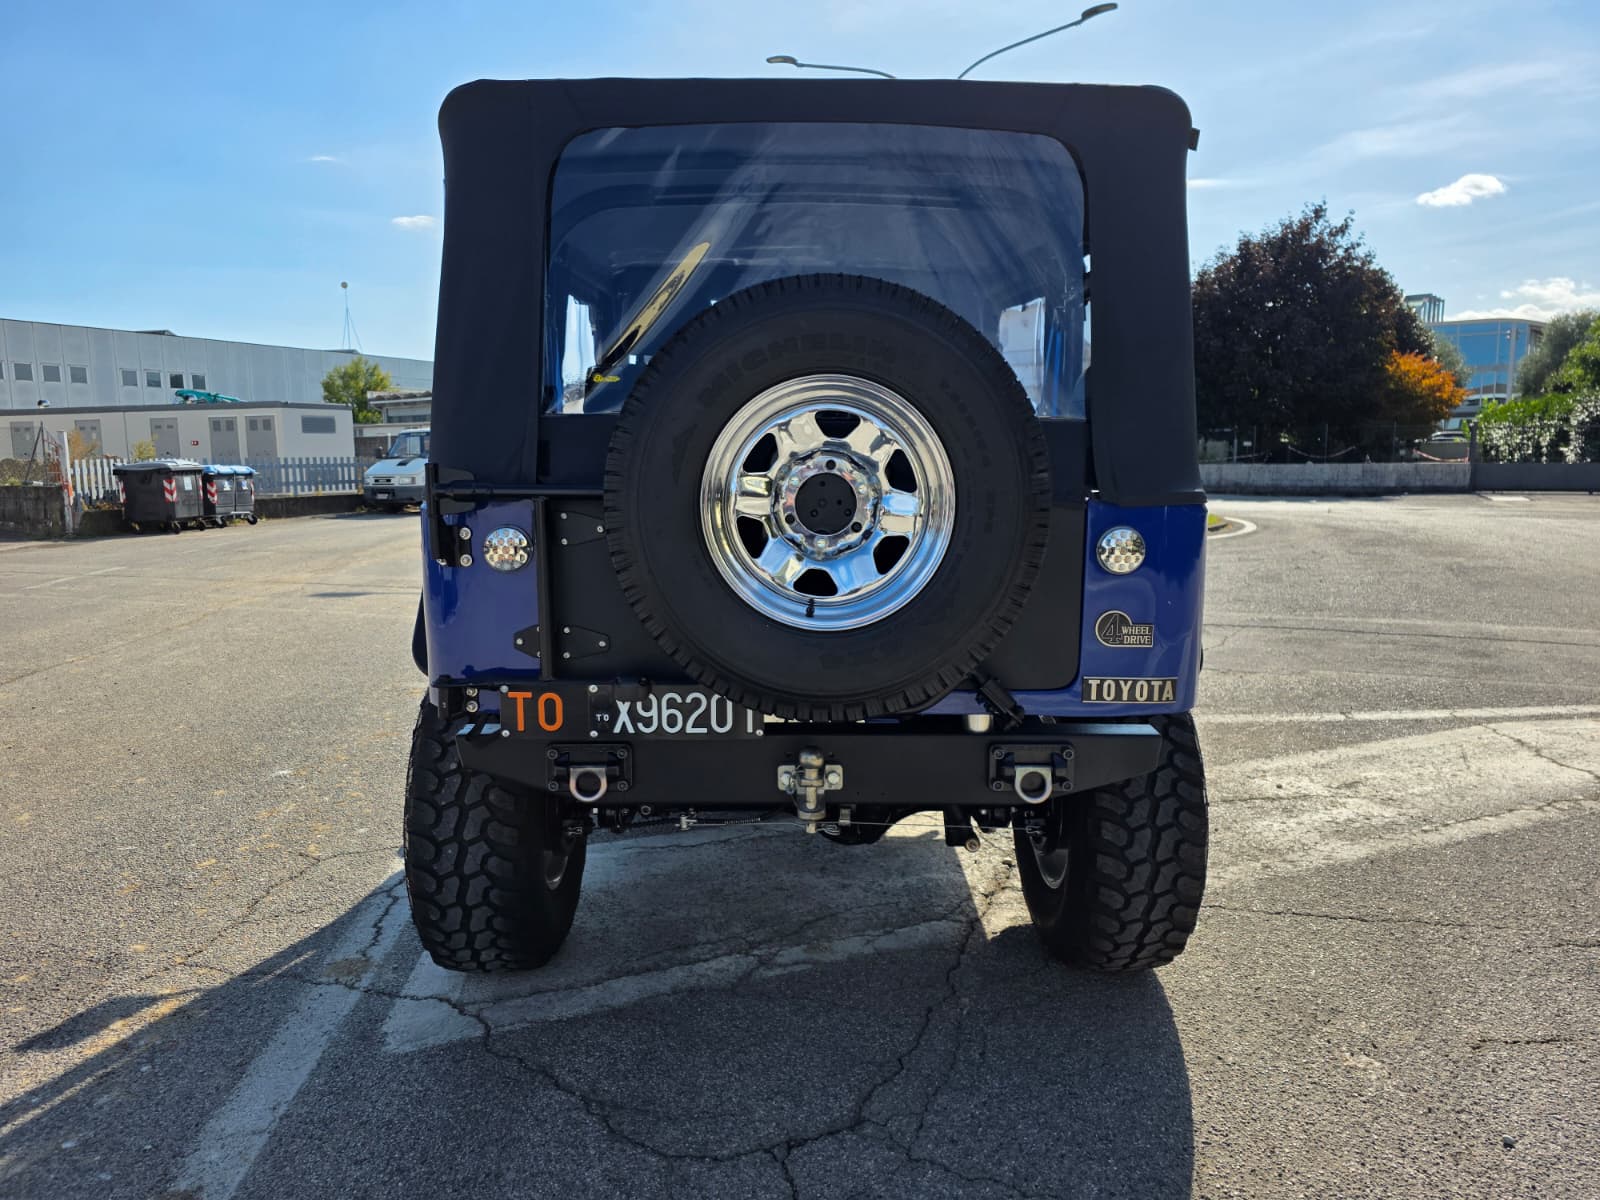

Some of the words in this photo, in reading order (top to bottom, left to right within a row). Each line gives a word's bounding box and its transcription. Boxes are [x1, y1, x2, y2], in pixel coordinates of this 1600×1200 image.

[1101, 614, 1122, 644] 4
[1121, 626, 1151, 635] WHEEL
[1123, 635, 1151, 645] DRIVE
[1088, 679, 1174, 702] TOYOTA
[507, 691, 563, 732] TO
